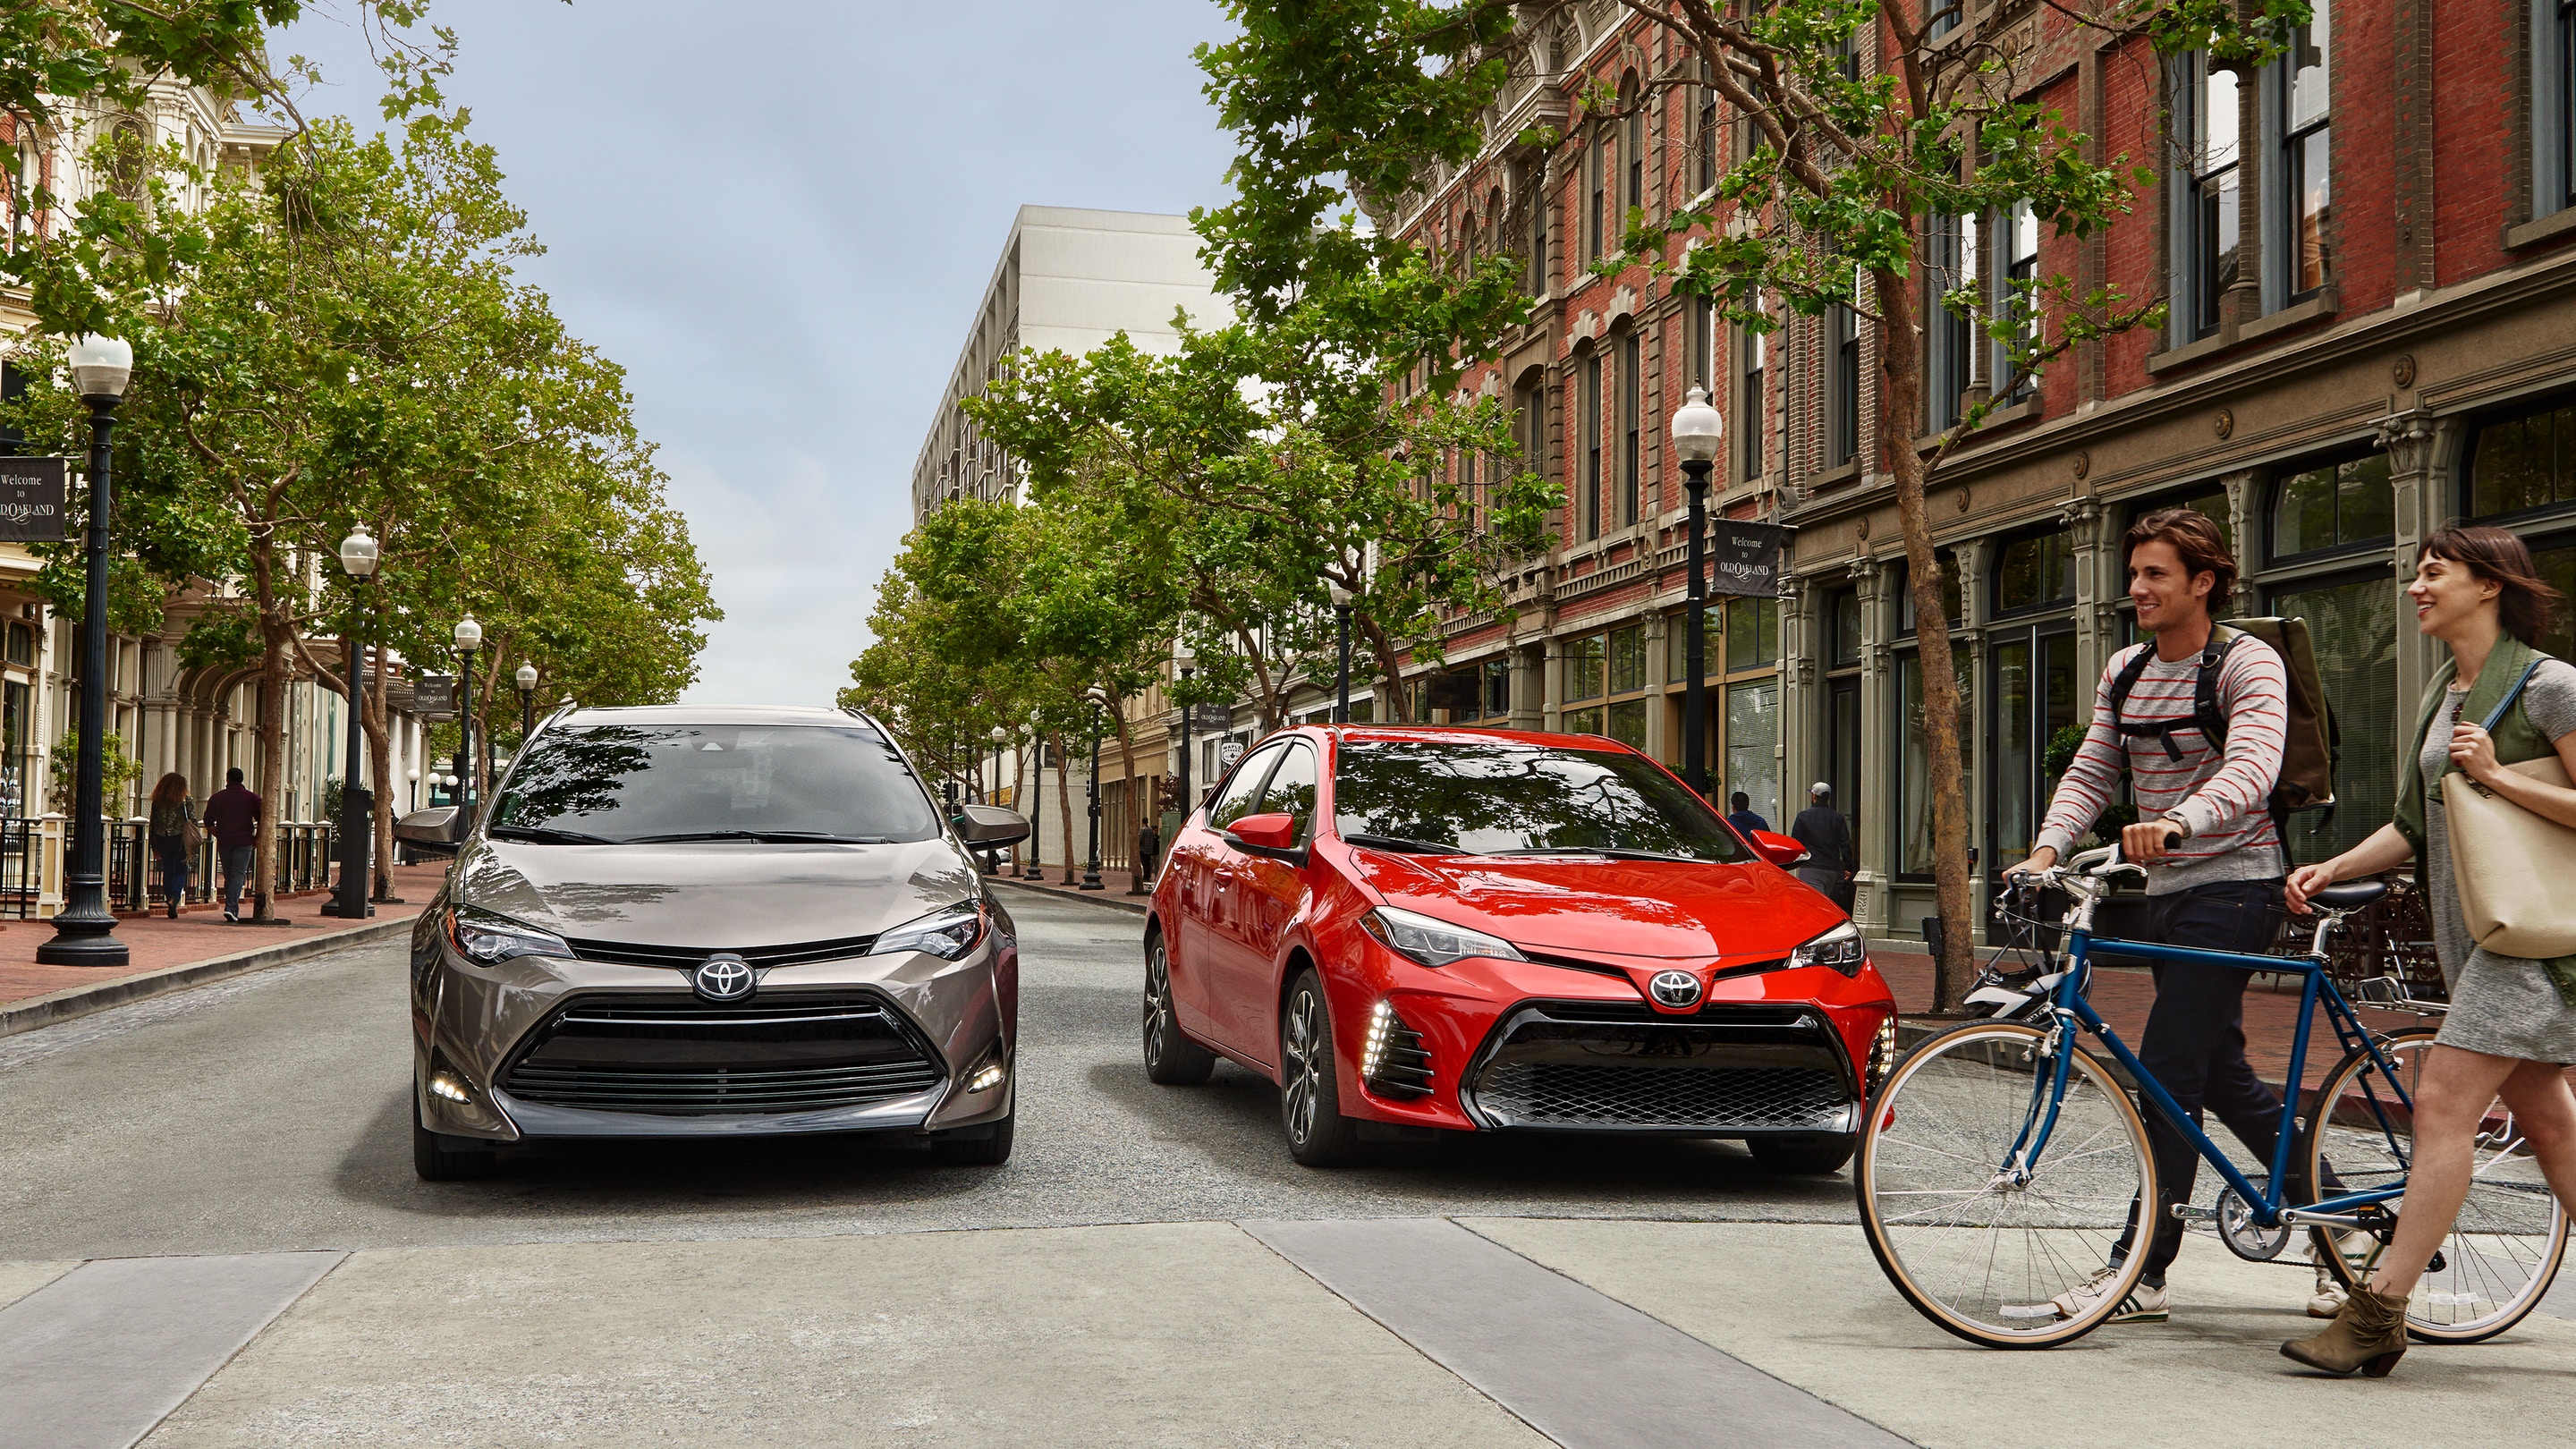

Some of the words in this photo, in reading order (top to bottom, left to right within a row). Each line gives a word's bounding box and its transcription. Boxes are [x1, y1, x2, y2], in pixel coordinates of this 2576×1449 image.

[1, 474, 42, 486] Welcome
[1732, 536, 1762, 547] Welcome
[1741, 551, 1749, 559] to
